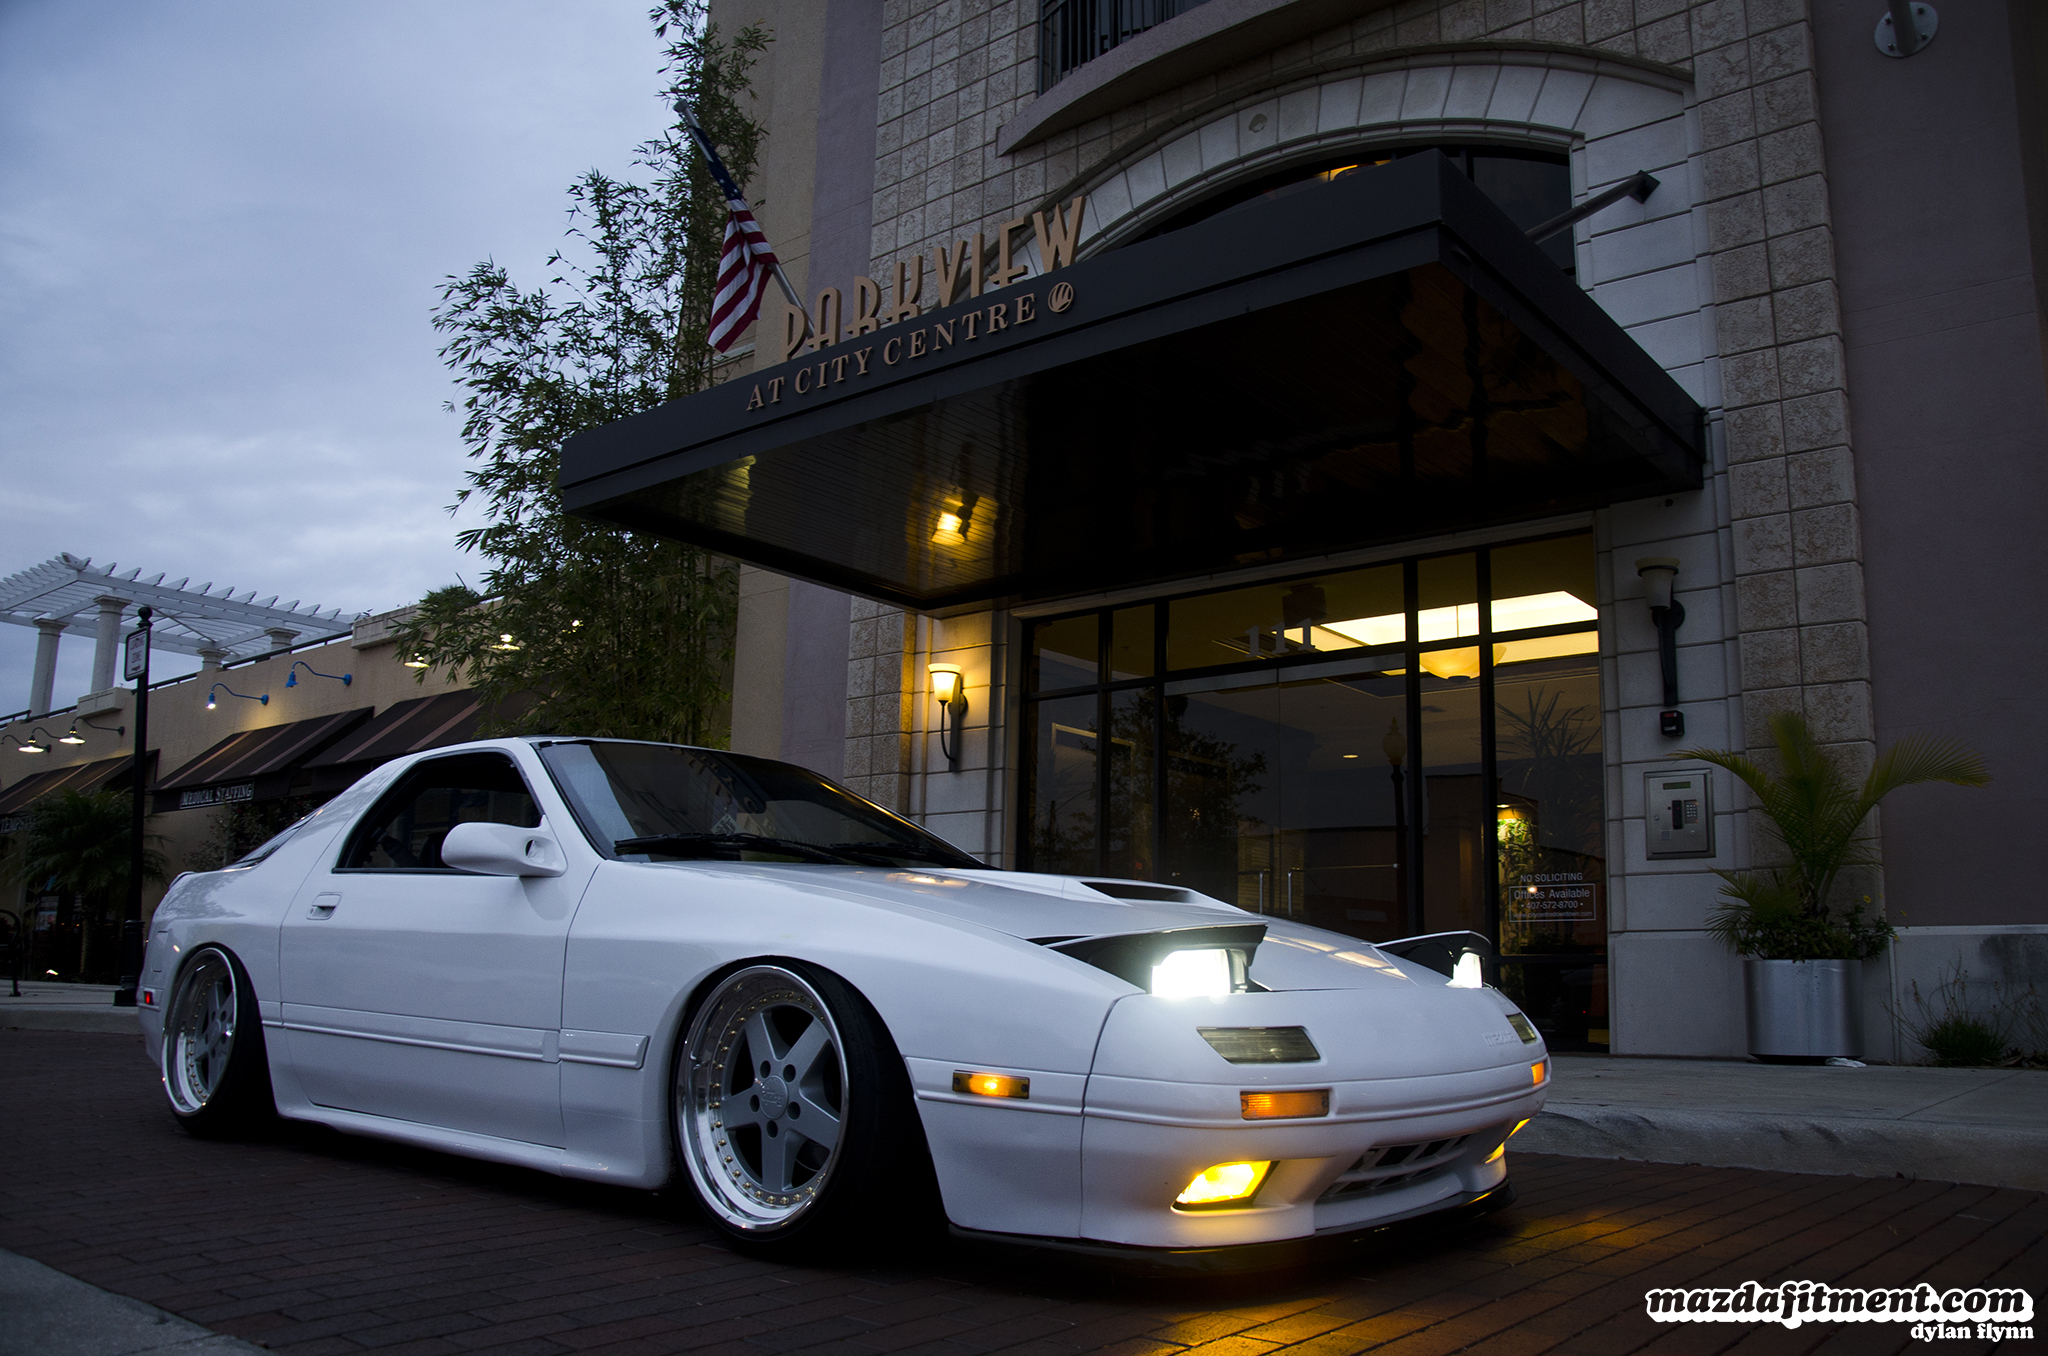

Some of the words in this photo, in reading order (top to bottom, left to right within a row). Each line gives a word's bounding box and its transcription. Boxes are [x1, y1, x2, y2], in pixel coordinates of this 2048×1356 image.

[783, 196, 1086, 362] PARKVIEW
[746, 376, 786, 411] AT
[794, 346, 873, 395] CITY
[883, 292, 1037, 367] CENTRE
[1244, 617, 1316, 658] 111
[181, 788, 215, 806] MEDICAL
[215, 783, 252, 802] STAFFING
[1520, 874, 1533, 883] NO
[1534, 872, 1583, 882] SOLICITING
[1513, 889, 1546, 900] Offices
[1549, 888, 1591, 899] Available
[1526, 901, 1579, 910] 407-572-8700
